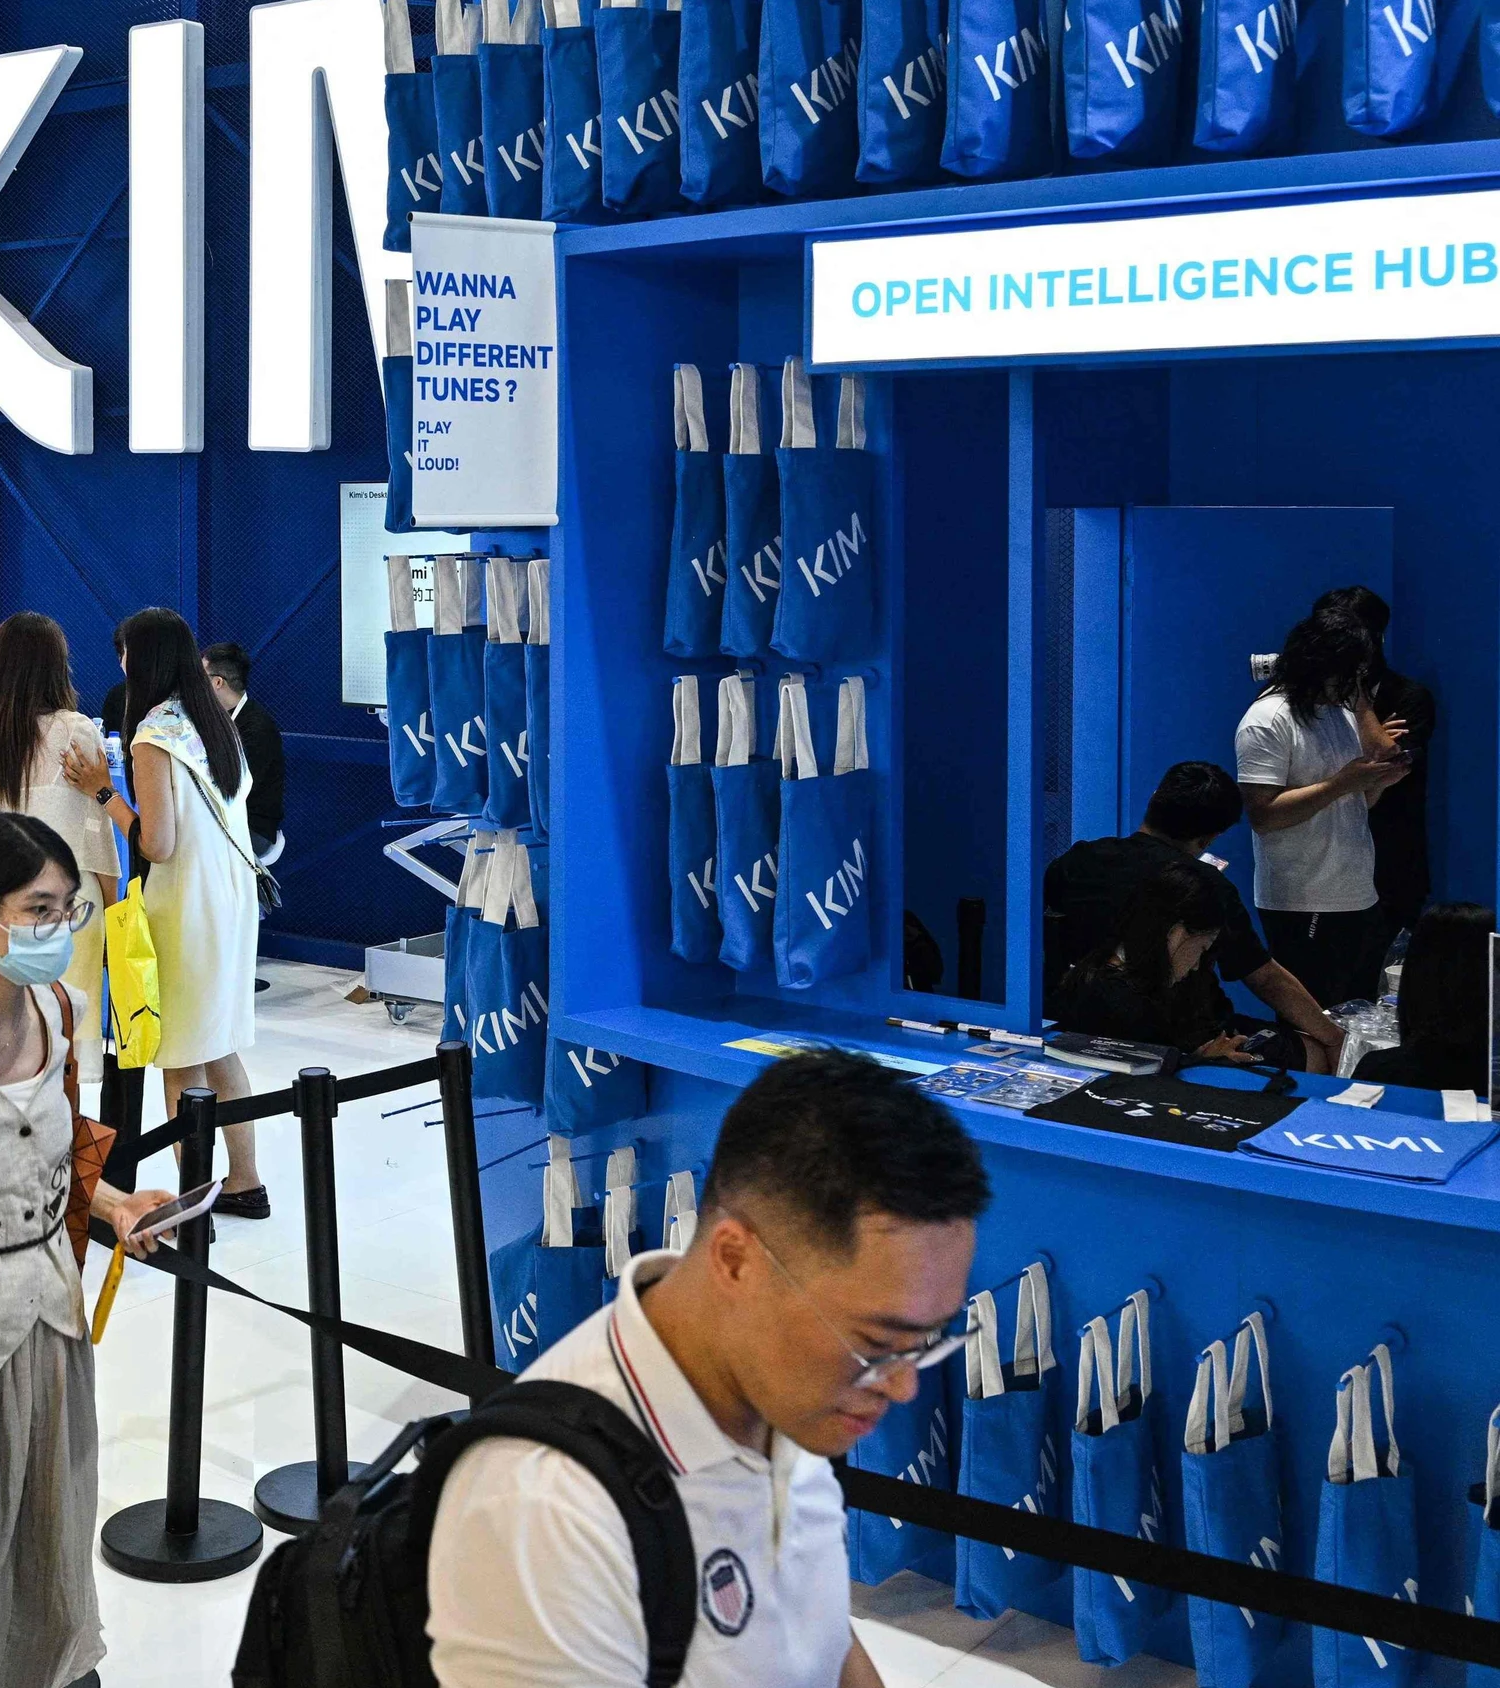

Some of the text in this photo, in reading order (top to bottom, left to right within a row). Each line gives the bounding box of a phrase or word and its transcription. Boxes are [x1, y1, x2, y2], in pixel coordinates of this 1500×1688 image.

[416, 270, 516, 299] WANNA
[851, 241, 1498, 318] OPEN INTELLIGENCE HUB
[417, 306, 481, 332] PLAY
[417, 341, 553, 369] DIFFERENT
[417, 421, 452, 434] PLAY
[417, 439, 429, 452] IT
[417, 457, 459, 471] LOUD!
[348, 491, 368, 499] Kimi's
[797, 512, 866, 597] KIM
[806, 838, 866, 929] KIM
[1283, 1131, 1445, 1153] KIMI
